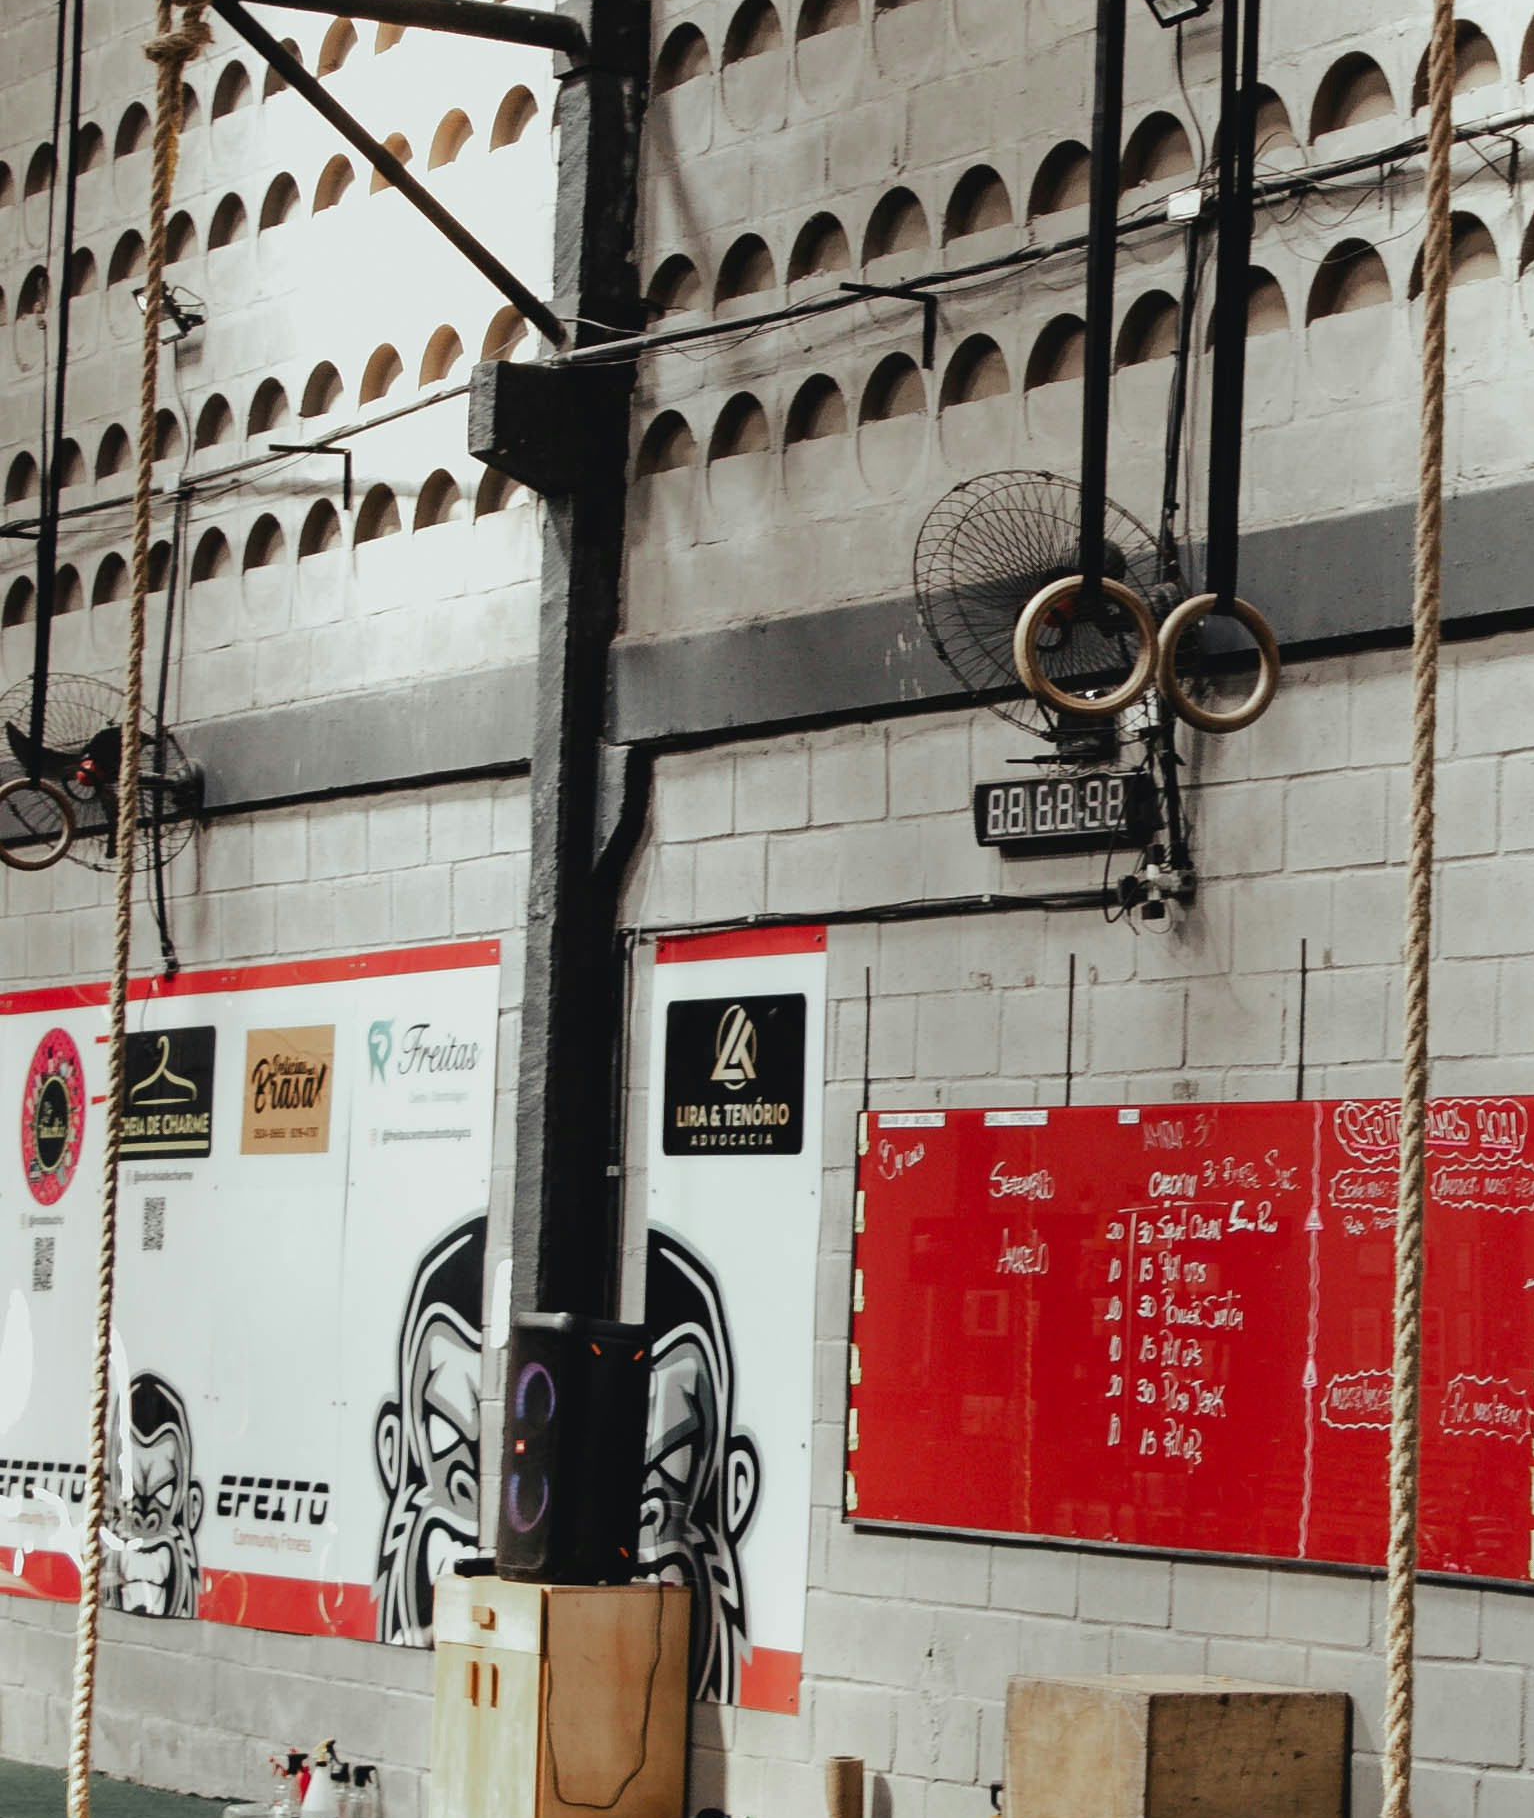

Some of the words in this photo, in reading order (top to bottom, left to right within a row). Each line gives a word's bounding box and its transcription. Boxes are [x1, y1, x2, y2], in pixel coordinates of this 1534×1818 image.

[397, 1023, 479, 1075] Freitas
[162, 1112, 210, 1135] CHARME
[676, 1104, 708, 1127] LIRA
[709, 1104, 722, 1126] &
[723, 1096, 790, 1126] TENÓRIO
[689, 1132, 774, 1147] ADVOCACIA
[216, 1475, 330, 1525] EFEITO
